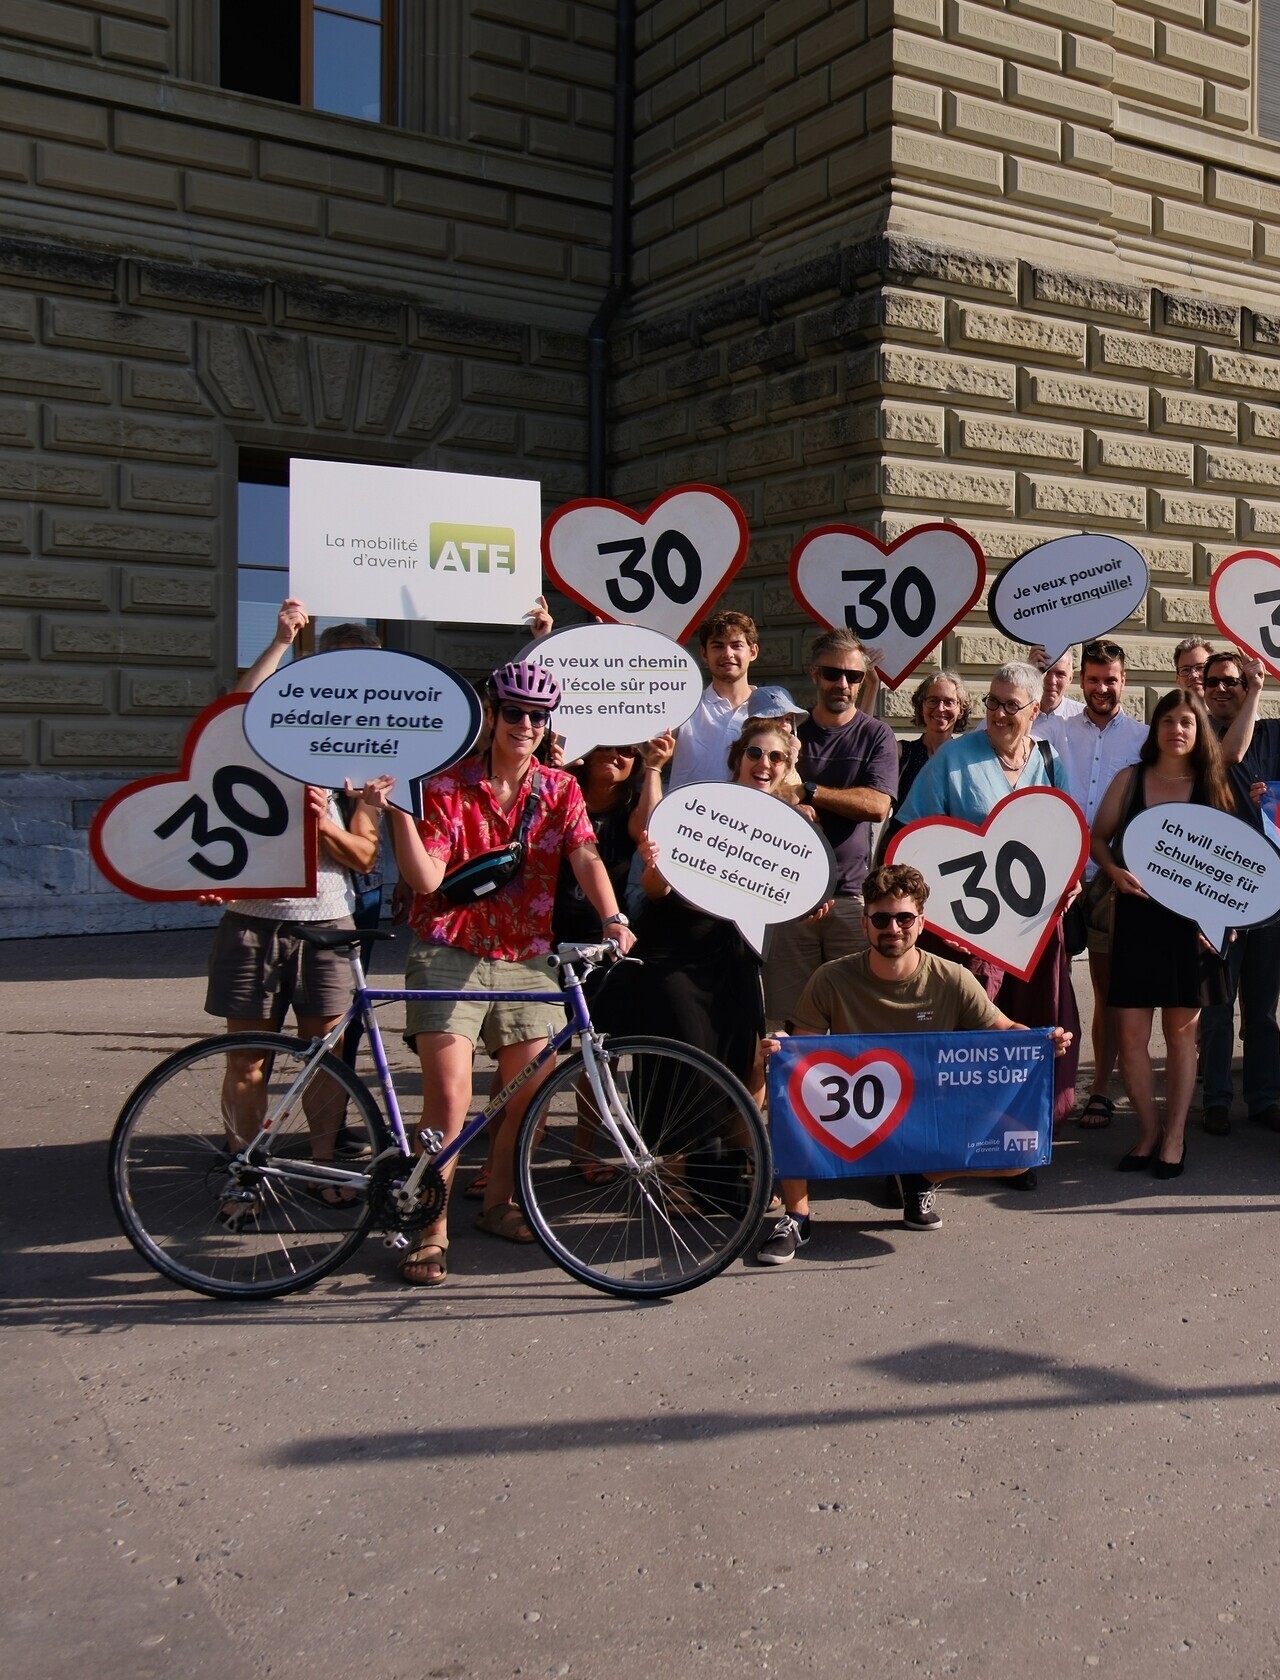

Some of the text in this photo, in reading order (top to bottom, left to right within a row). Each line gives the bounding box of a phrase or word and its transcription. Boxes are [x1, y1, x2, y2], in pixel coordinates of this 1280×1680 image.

[326, 534, 418, 551] La mobilité
[353, 554, 418, 569] d'avenir
[434, 541, 512, 574] ATE
[597, 529, 702, 614] 30
[1013, 558, 1122, 599] Je veux pouvoir
[841, 566, 937, 640] 30
[1013, 575, 1133, 621] dormir tranquille!
[538, 655, 688, 668] Je veux un chemin
[279, 683, 442, 704] Je veux pouvoir
[621, 678, 645, 691] sûr
[649, 681, 687, 694] pour
[270, 709, 443, 729] pédaler en toute
[559, 702, 666, 715] mes enfants!
[309, 737, 399, 754] sécurité!
[154, 765, 290, 881] 30
[685, 799, 812, 859] Je veux pouvoir
[677, 824, 800, 882] me déplacer en
[1155, 839, 1259, 894] Schulwege für
[1161, 819, 1266, 874] Ich will sichere
[671, 847, 791, 904] toute sécurité!
[938, 840, 1046, 935] 30
[1147, 862, 1249, 913] meine Kinder!
[938, 1046, 1045, 1064] MOINS VITE,
[938, 1065, 1028, 1086] PLUS SÛR!
[819, 1074, 885, 1122] 30
[1007, 1138, 1036, 1152] ATE
